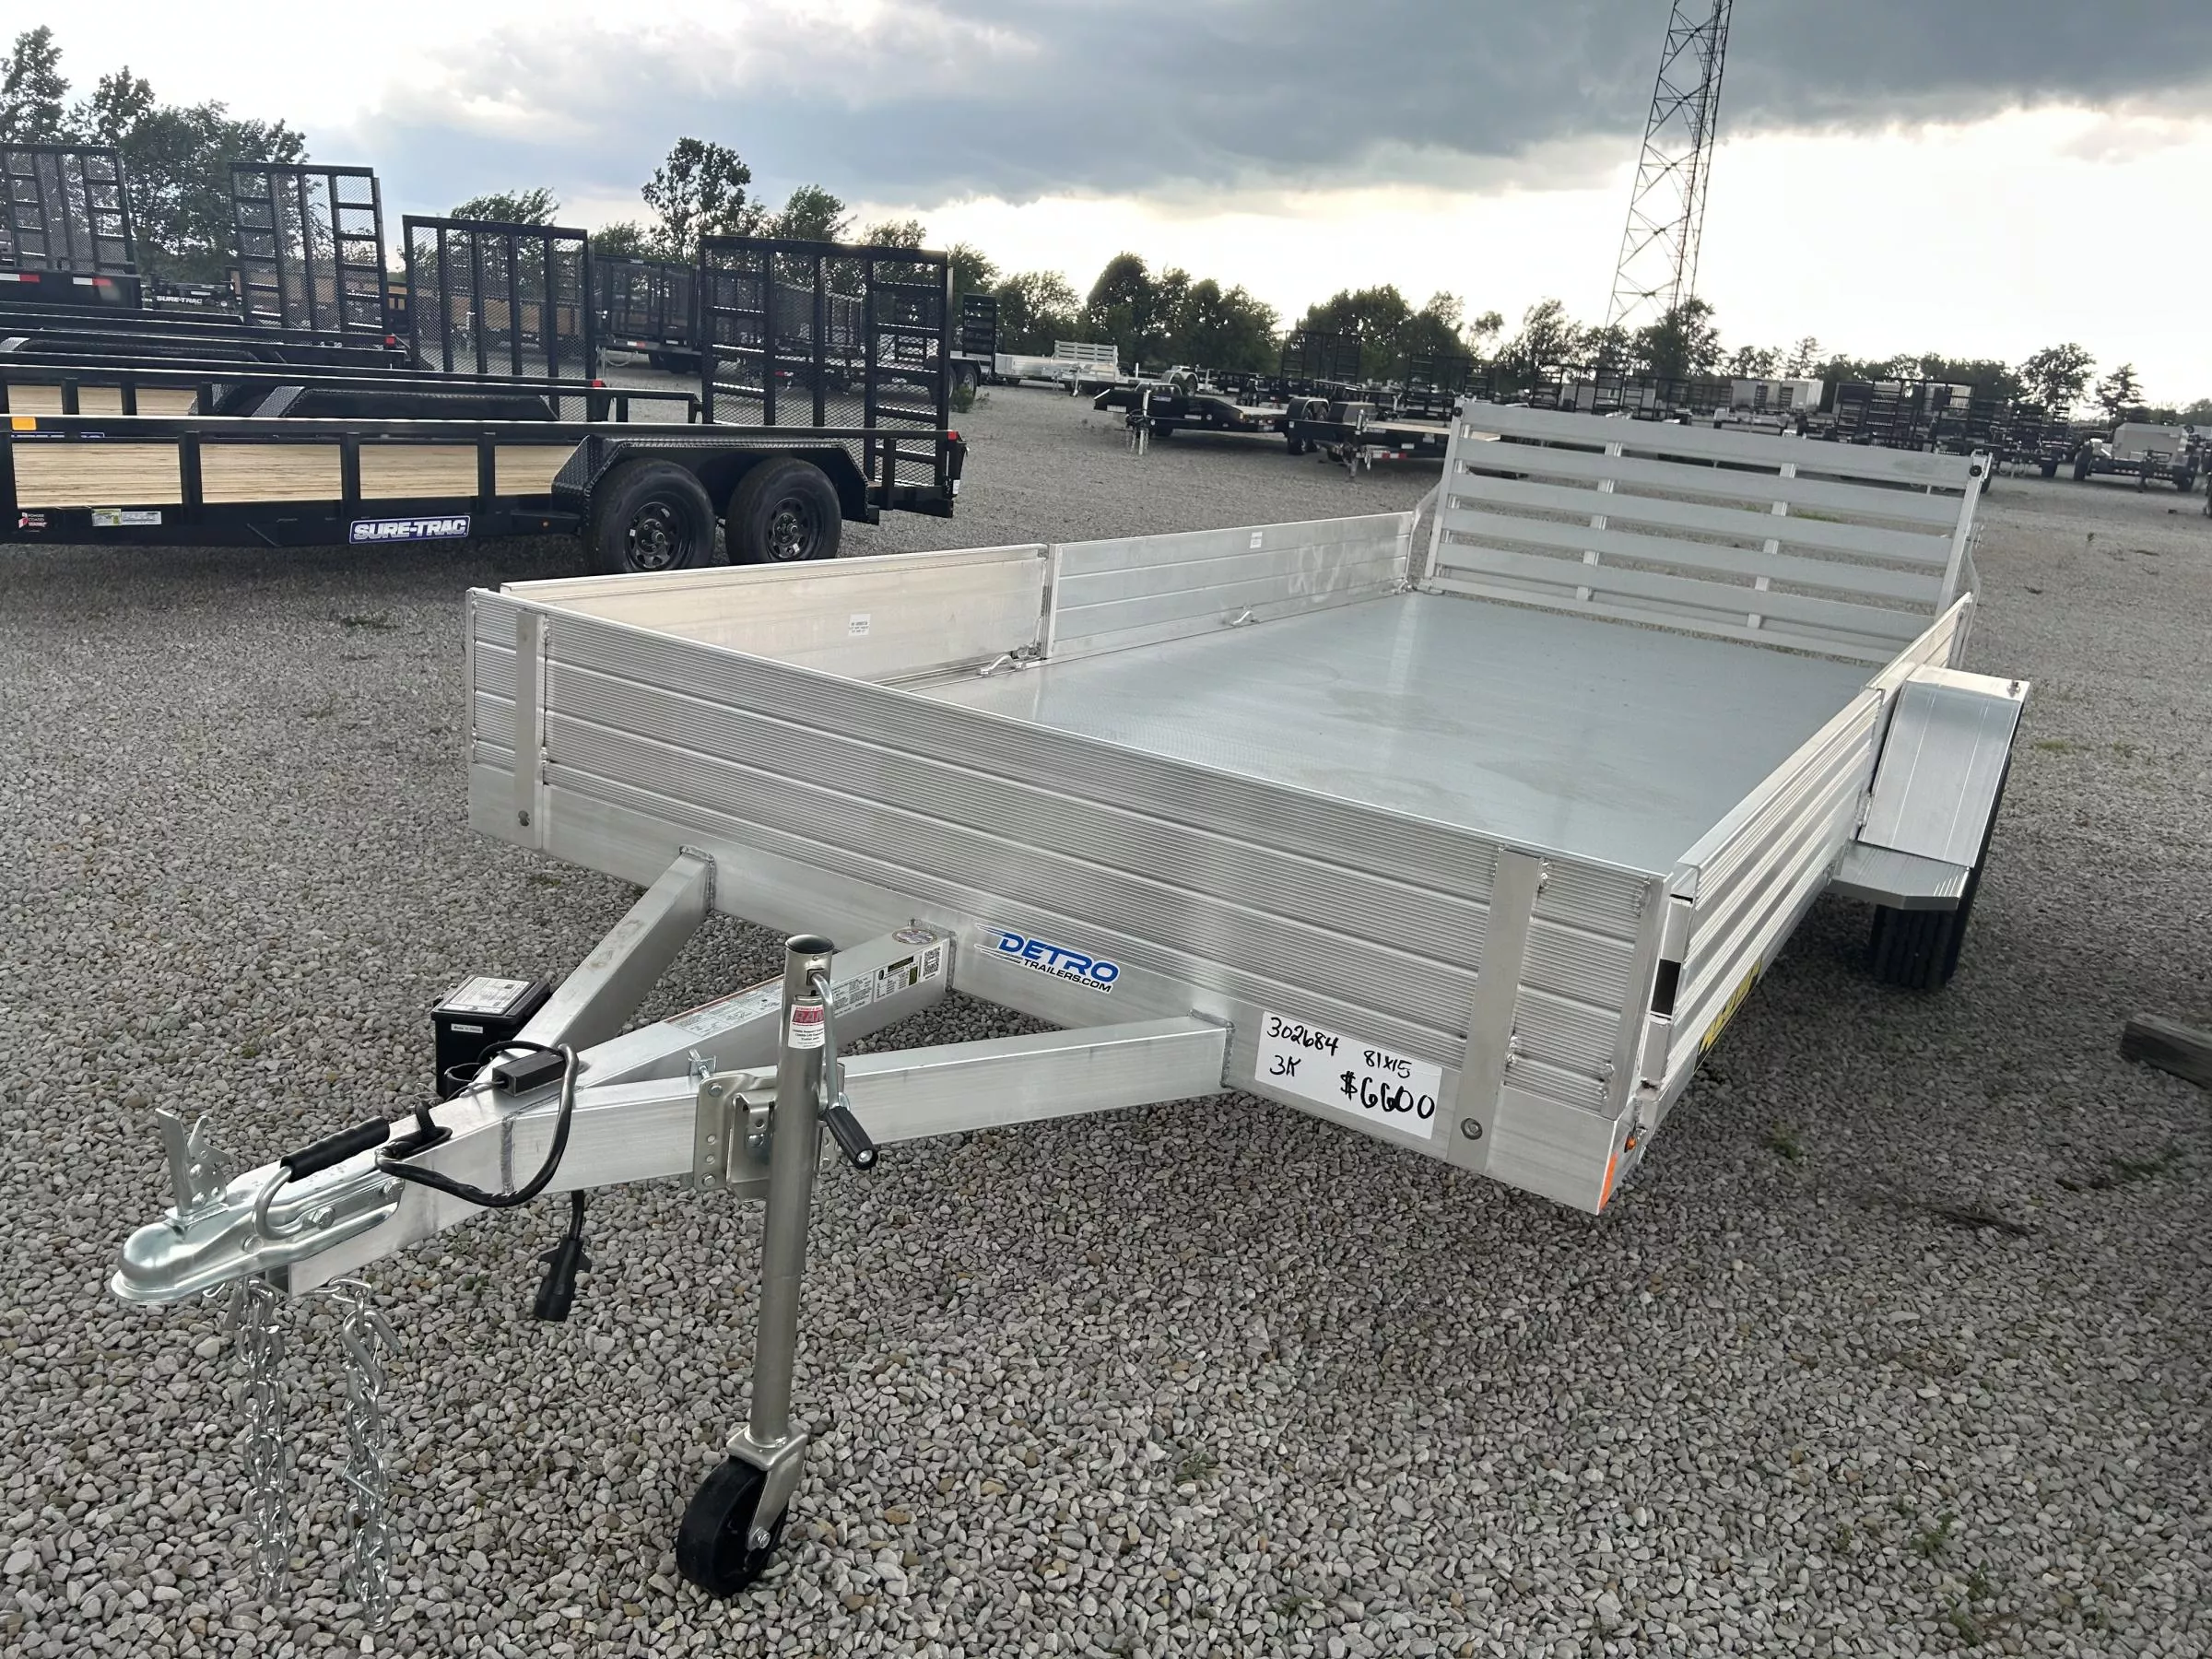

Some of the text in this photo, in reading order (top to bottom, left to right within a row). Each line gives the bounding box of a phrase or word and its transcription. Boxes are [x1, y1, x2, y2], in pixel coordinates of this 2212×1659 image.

[156, 295, 203, 305] SURE-TRAC
[354, 520, 466, 540] SURE-TRAC
[999, 933, 1119, 982] DETRO
[1024, 959, 1112, 993] TRAILERS.COM
[1266, 1017, 1339, 1056] 302684
[1269, 1054, 1435, 1119] 3K $6600
